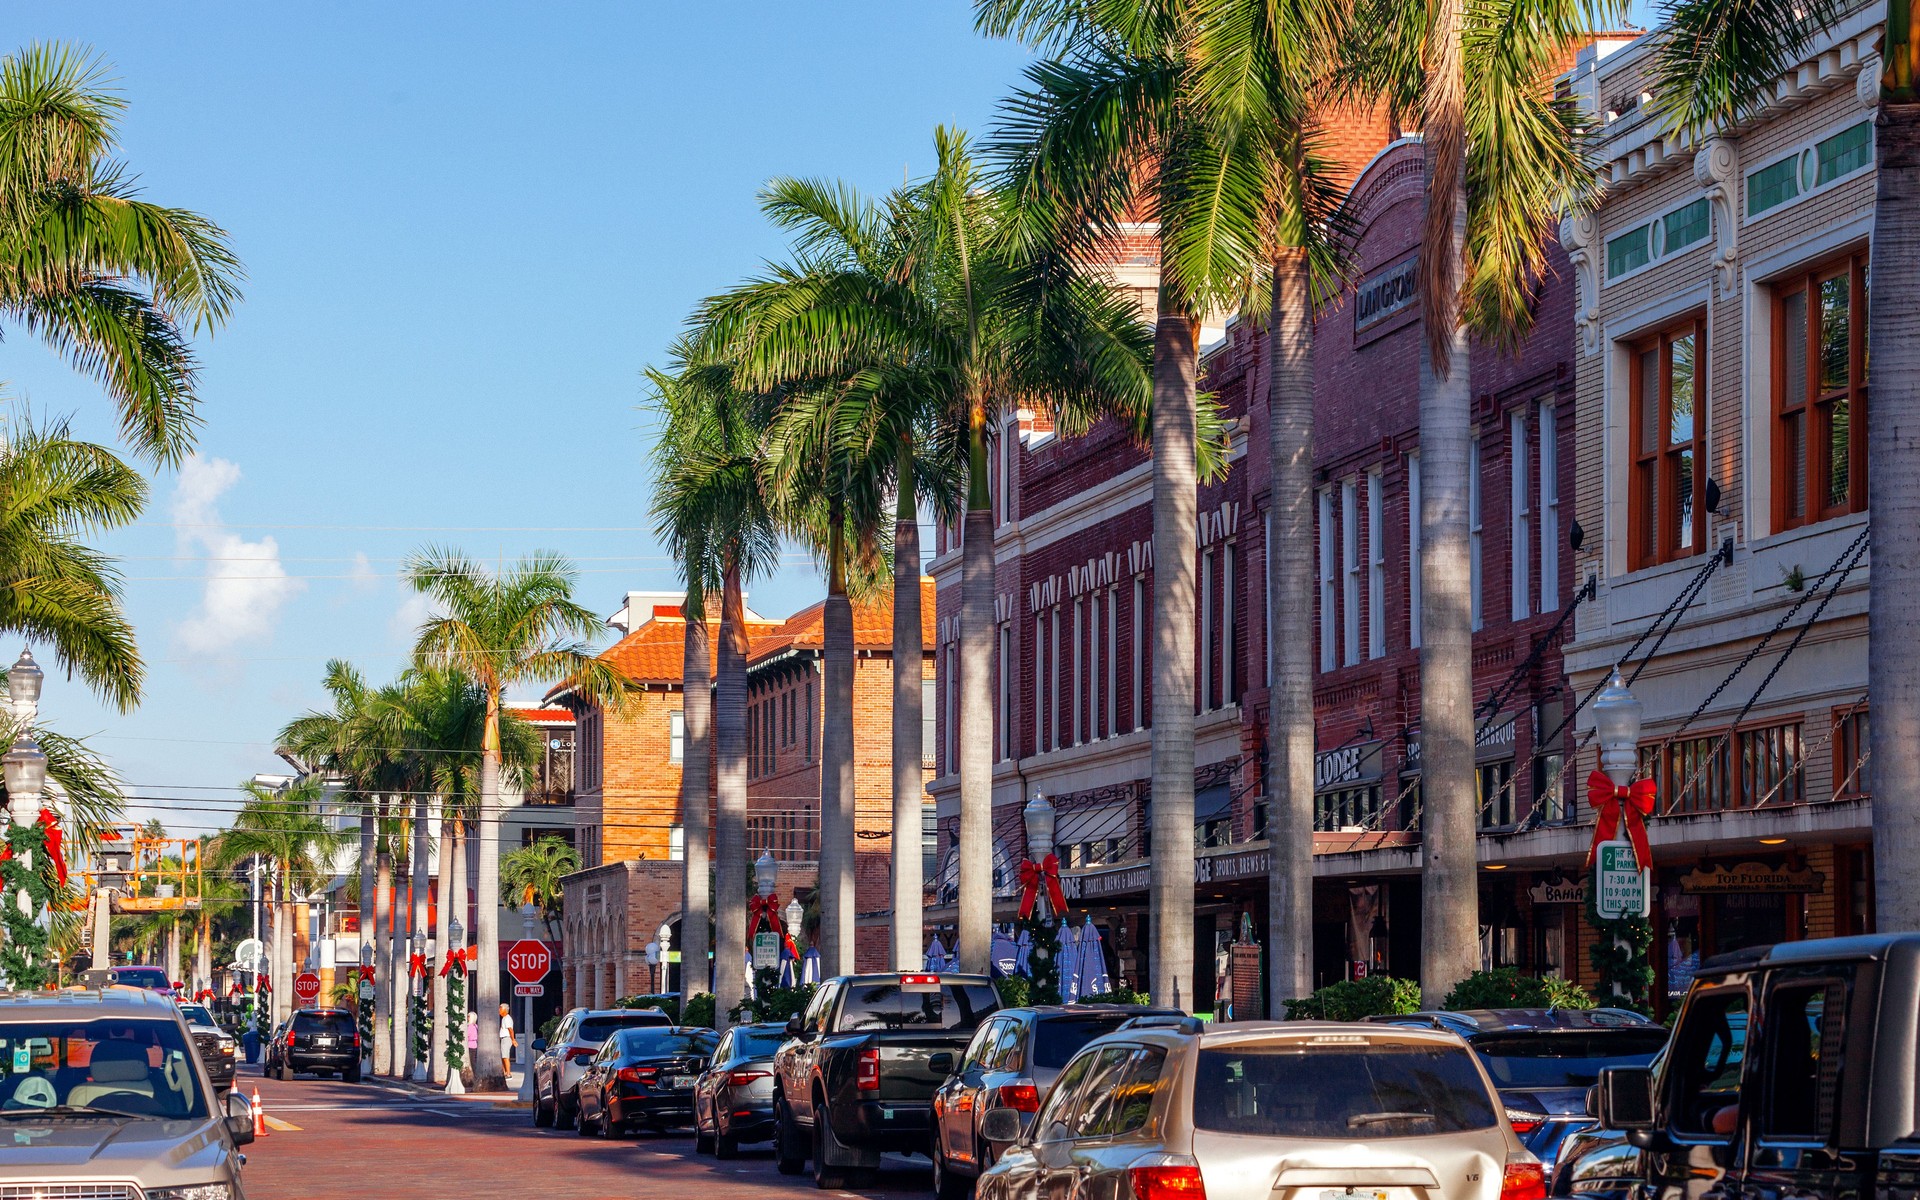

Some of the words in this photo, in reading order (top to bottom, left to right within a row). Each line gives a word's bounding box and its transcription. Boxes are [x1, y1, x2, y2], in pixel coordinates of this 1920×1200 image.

[1475, 721, 1516, 748] BARBEQUE
[1316, 747, 1360, 786] LODGE
[1606, 853, 1613, 866] 2
[1616, 850, 1624, 858] HR
[1216, 858, 1238, 878] SPORTS,
[1240, 855, 1259, 874] BREWS
[1261, 854, 1266, 872] &
[1609, 875, 1625, 885] 7:30
[1627, 875, 1637, 885] AM
[1061, 877, 1081, 900] ODGE
[1104, 875, 1121, 892] BREWS
[1605, 888, 1613, 897] TO
[1615, 888, 1631, 897] 9:00
[1632, 888, 1641, 897] PM
[1606, 900, 1622, 909] THIS
[1625, 900, 1640, 909] SIDE
[511, 953, 547, 969] STOP
[297, 981, 319, 991] STOP
[1466, 1173, 1480, 1182] V6
